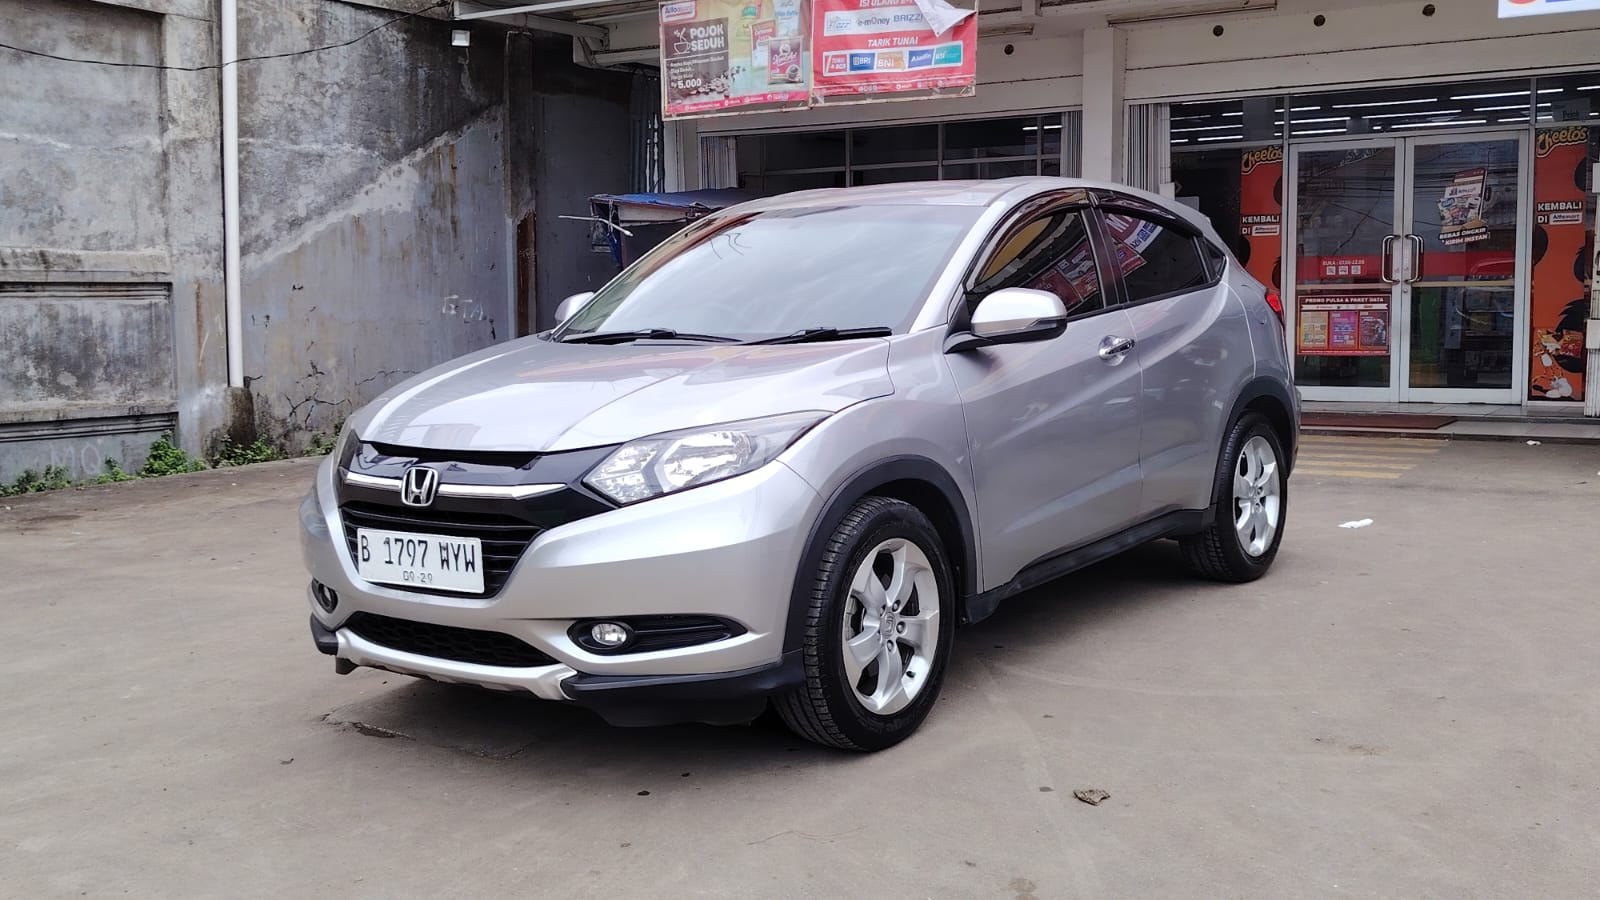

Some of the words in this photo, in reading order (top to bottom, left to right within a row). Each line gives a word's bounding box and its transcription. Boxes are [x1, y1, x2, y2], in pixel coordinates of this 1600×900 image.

[690, 24, 724, 39] POJOK
[691, 36, 725, 51] SEDUH
[867, 39, 891, 47] TARIK
[892, 37, 918, 46] TUNAI
[859, 57, 871, 65] BRI
[878, 59, 894, 67] BNI
[678, 78, 702, 89] 5.000
[1536, 127, 1587, 155] Cheetos
[1241, 146, 1282, 172] Cheetos
[1538, 202, 1582, 211] KEMBALI
[1242, 215, 1279, 224] KEMBALI
[1538, 215, 1547, 224] DI
[1461, 227, 1486, 236] ONGKIR
[361, 535, 371, 562] B
[383, 537, 428, 568] 1797
[439, 541, 476, 573] WYW
